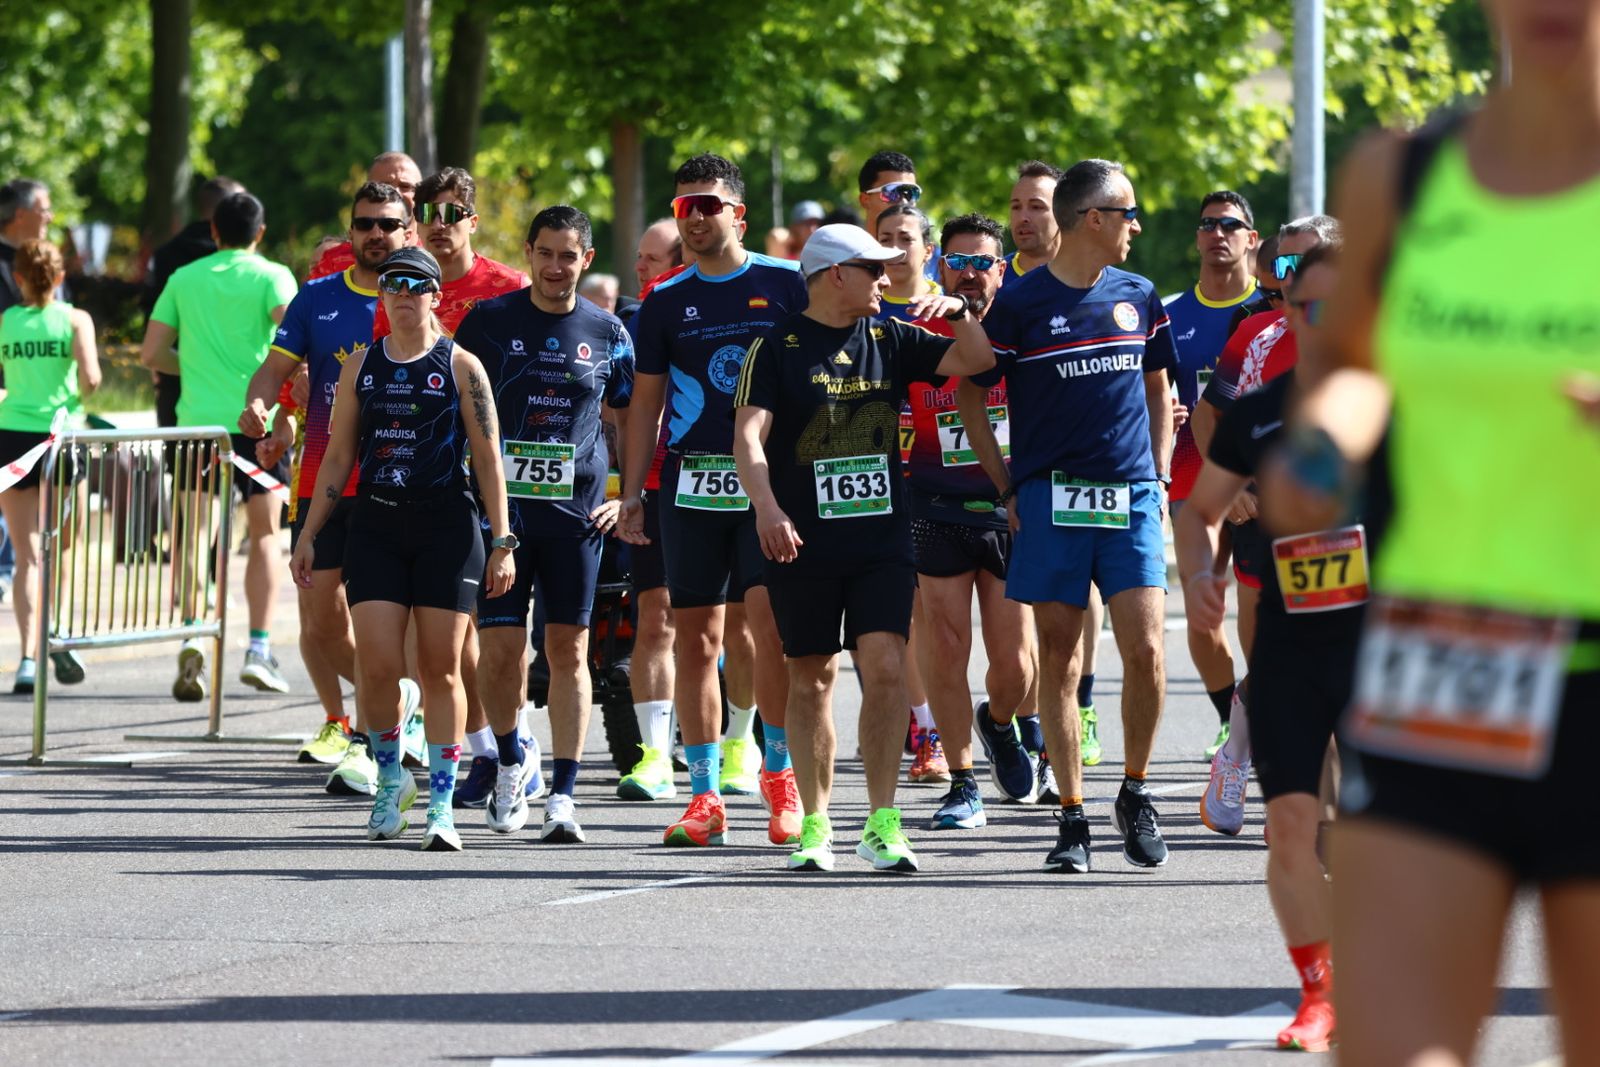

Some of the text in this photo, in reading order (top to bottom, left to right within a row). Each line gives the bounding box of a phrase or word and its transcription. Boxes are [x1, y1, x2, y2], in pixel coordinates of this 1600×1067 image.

[2, 341, 69, 360] RAQUEL
[826, 381, 871, 394] MADRID
[528, 394, 572, 408] MAGUISA
[375, 429, 417, 440] MAGUISA
[513, 457, 563, 484] 755
[836, 463, 870, 473] CARRERA
[691, 471, 740, 495] 756
[820, 471, 888, 502] 1633
[1064, 486, 1118, 511] 718
[1290, 553, 1351, 590] 577
